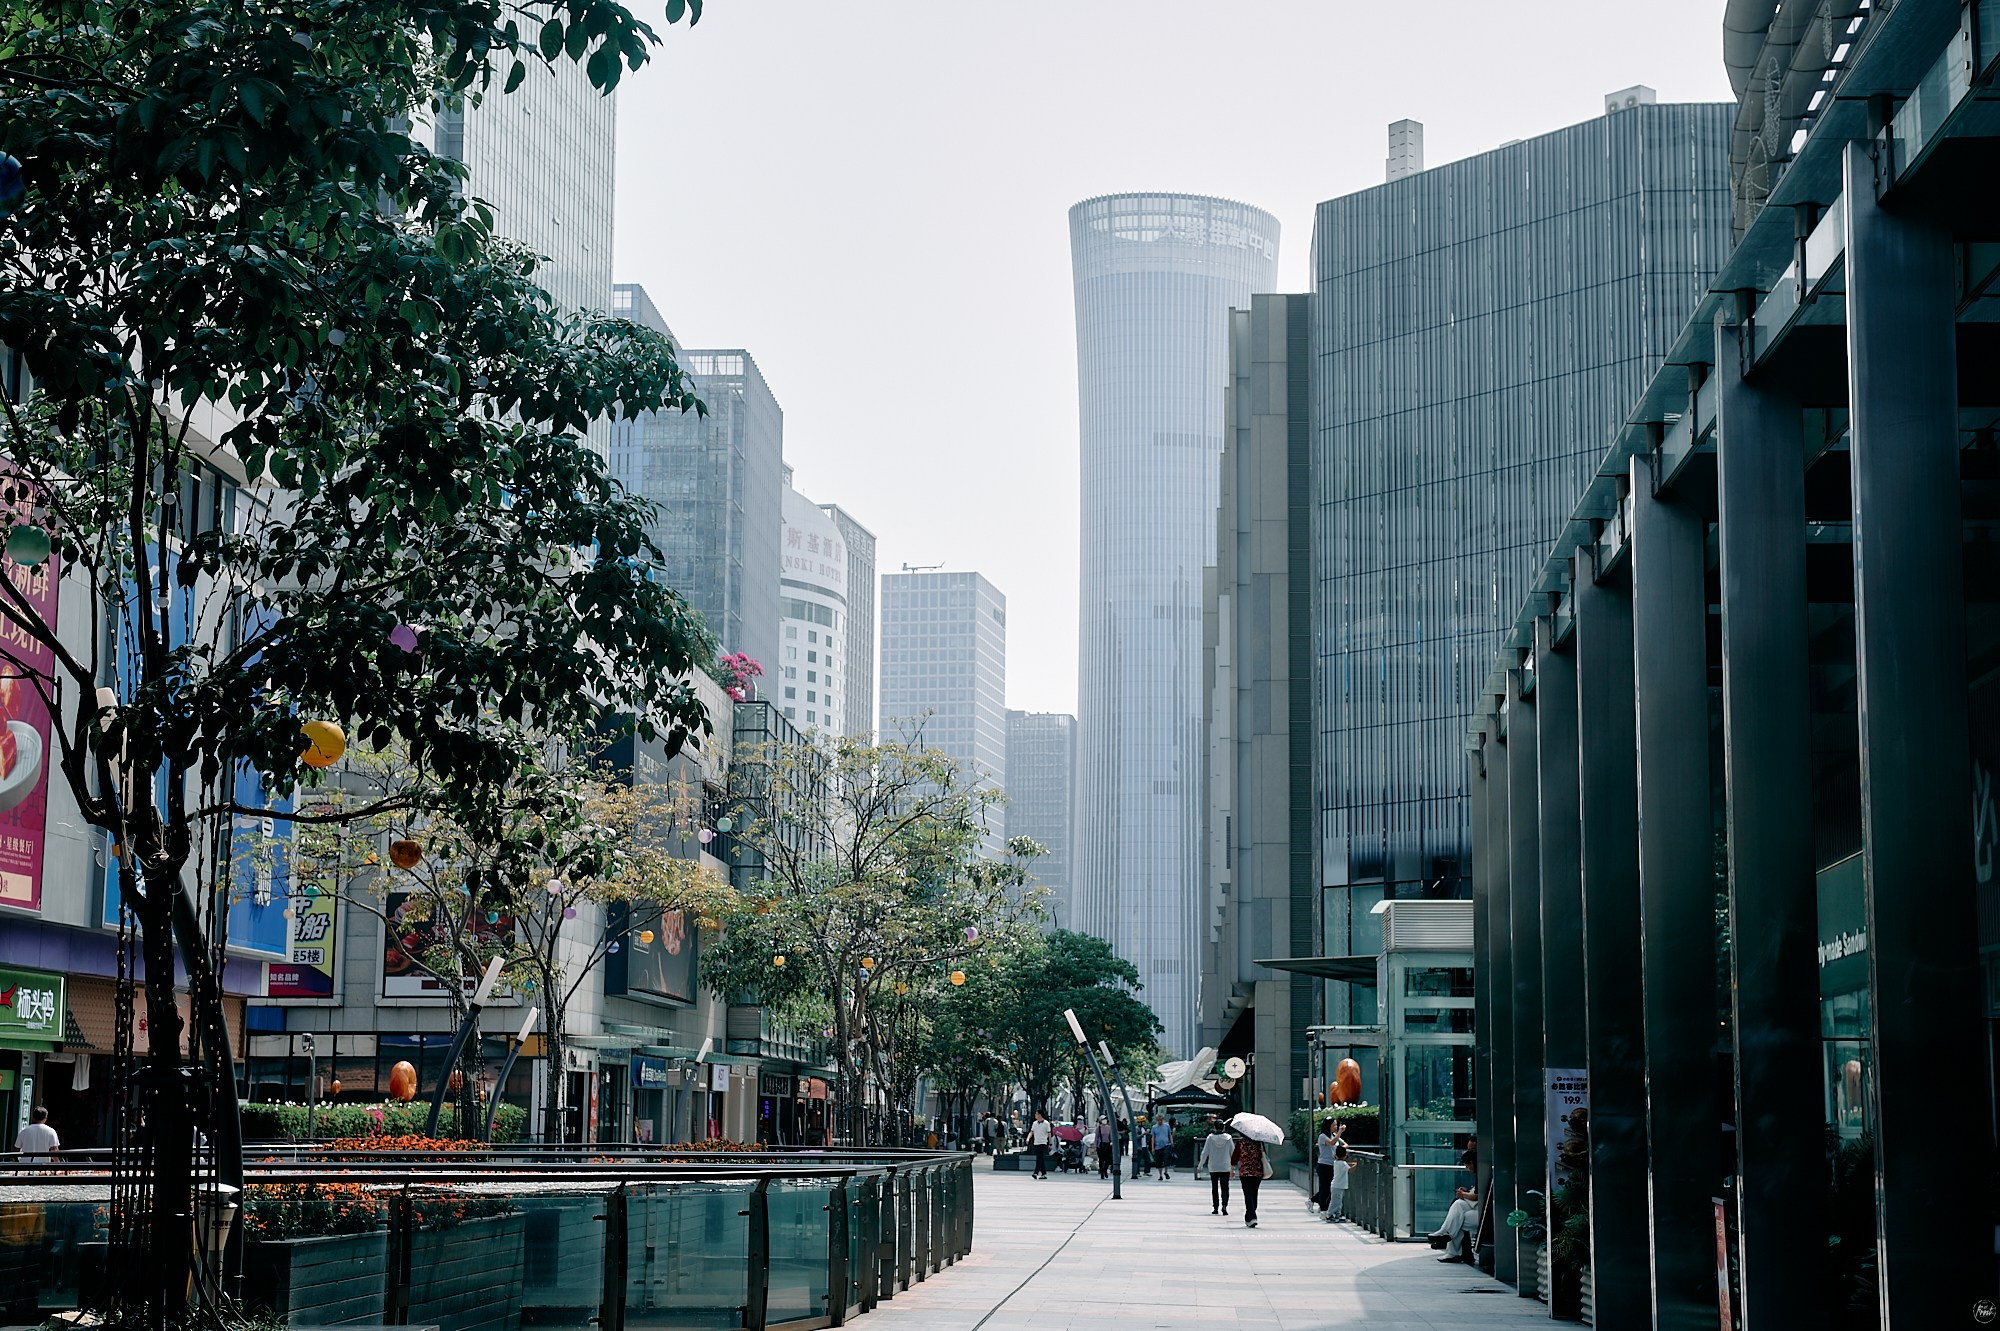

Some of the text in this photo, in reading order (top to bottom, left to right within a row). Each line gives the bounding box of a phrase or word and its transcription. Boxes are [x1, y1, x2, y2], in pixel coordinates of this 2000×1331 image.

[819, 562, 842, 583] HOTEL
[270, 973, 299, 983] 知名品牌
